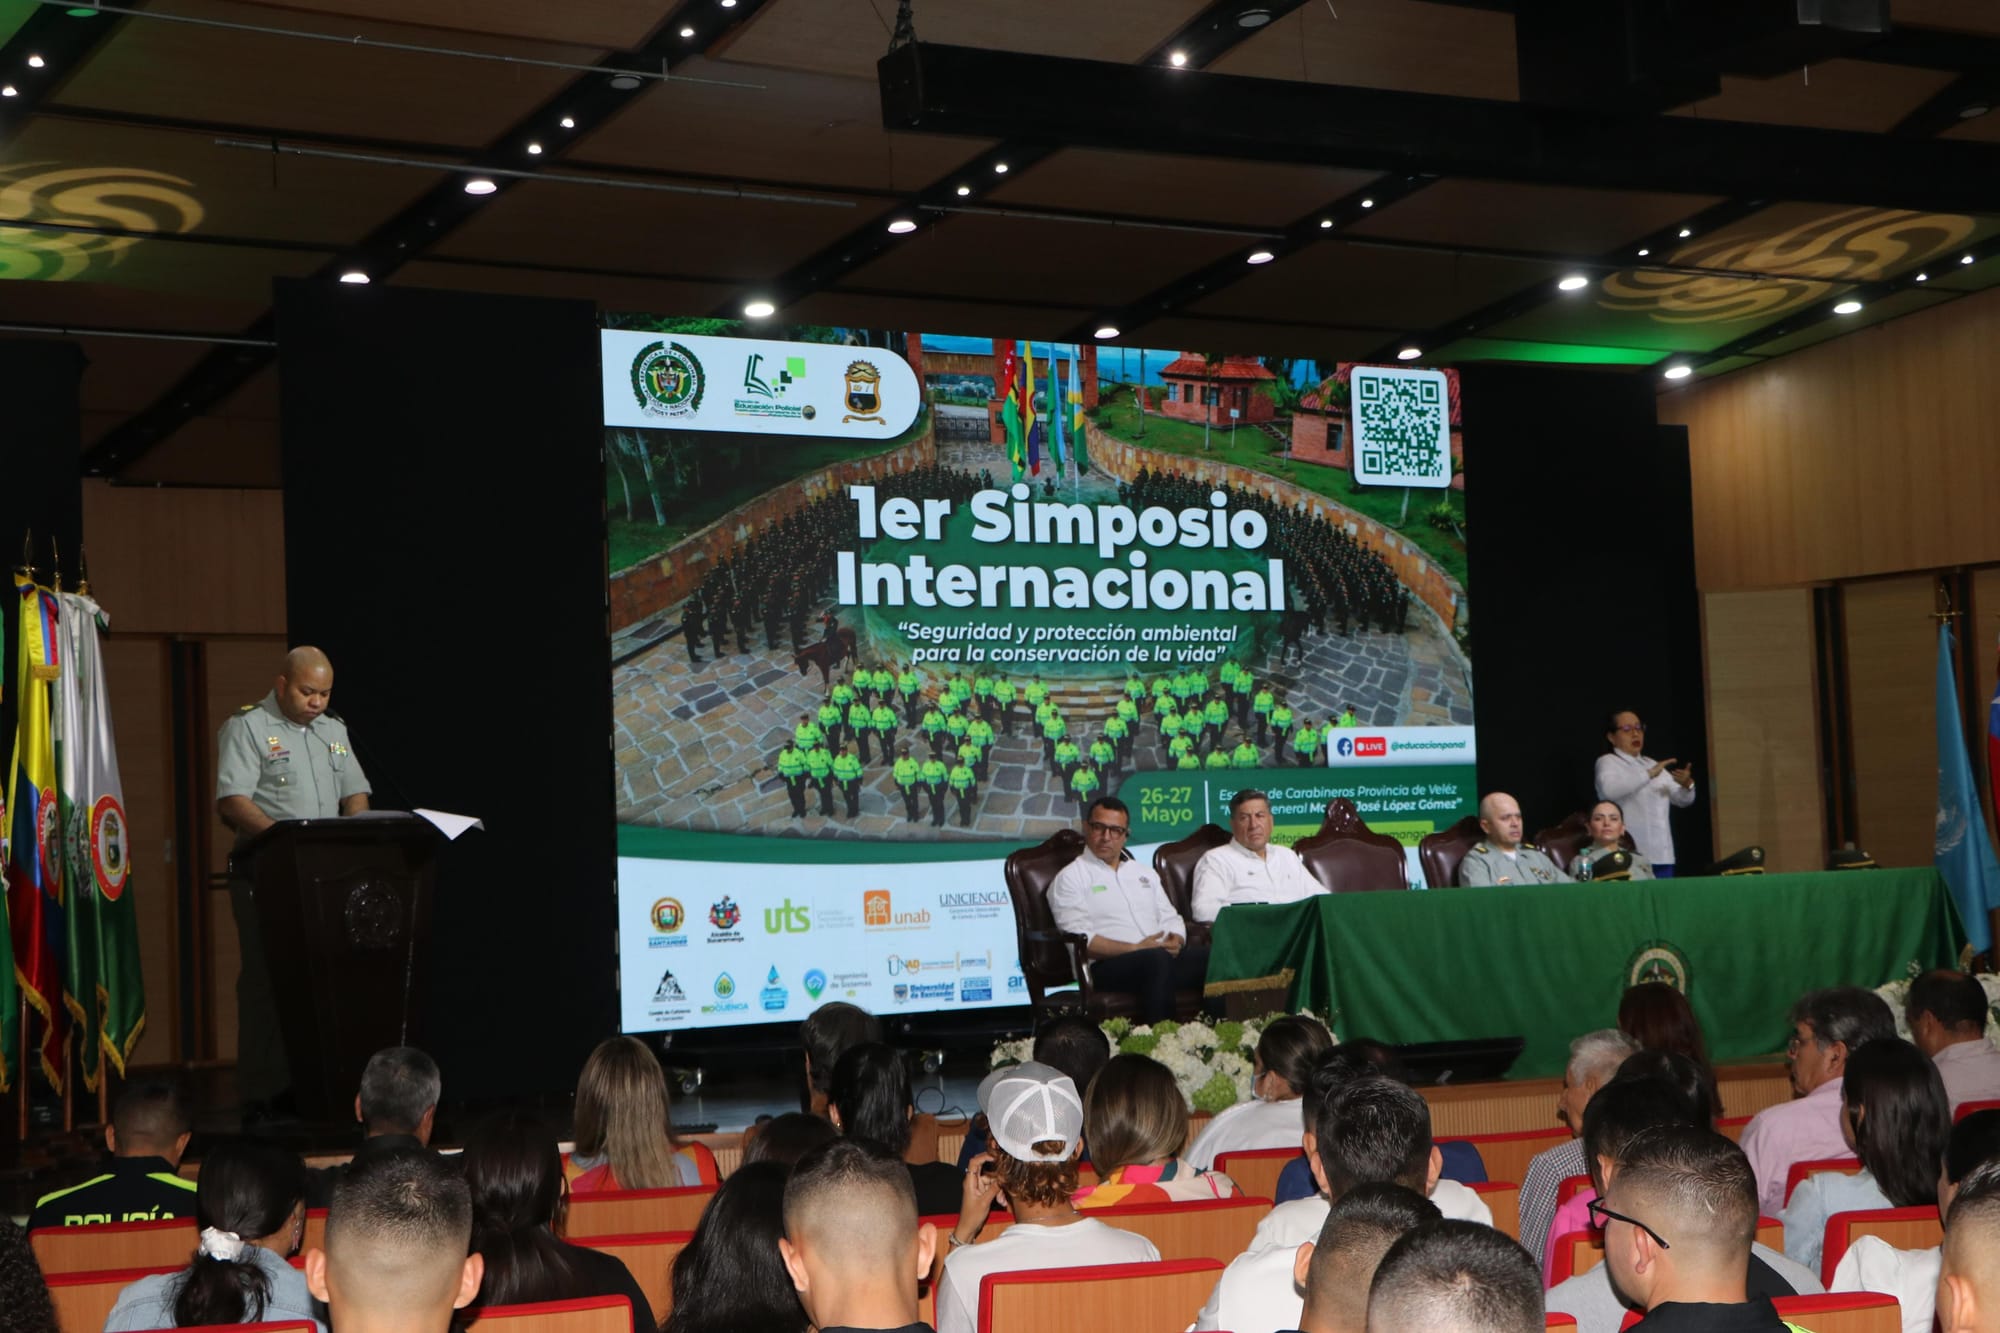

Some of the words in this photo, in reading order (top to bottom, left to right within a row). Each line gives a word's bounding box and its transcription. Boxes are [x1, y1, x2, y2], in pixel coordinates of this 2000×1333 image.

[850, 485, 951, 541] 1er
[970, 483, 1269, 559] Simposio
[836, 550, 1286, 611] Internacional
[1015, 626, 1029, 644] y
[1033, 623, 1136, 645] protección
[1141, 624, 1238, 642] ambiental
[912, 646, 960, 665] para
[966, 644, 984, 661] la
[990, 644, 1120, 662] conservación
[1125, 645, 1149, 662] de
[1154, 645, 1172, 662] la
[1365, 743, 1385, 751] LIVE
[1140, 786, 1193, 804] 26-27
[1267, 787, 1283, 799] de
[1285, 786, 1355, 799] Carabineros
[1357, 784, 1410, 797] Provincia
[1411, 785, 1426, 796] de
[1429, 783, 1458, 795] Veléz
[1141, 806, 1193, 826] Mayo
[1271, 803, 1307, 815] eneral
[1356, 799, 1381, 812] José
[1383, 799, 1417, 813] López
[939, 891, 1009, 905] UNICIENCIA
[764, 898, 811, 934] uts
[894, 908, 931, 924] unab
[910, 982, 955, 992] Universidad
